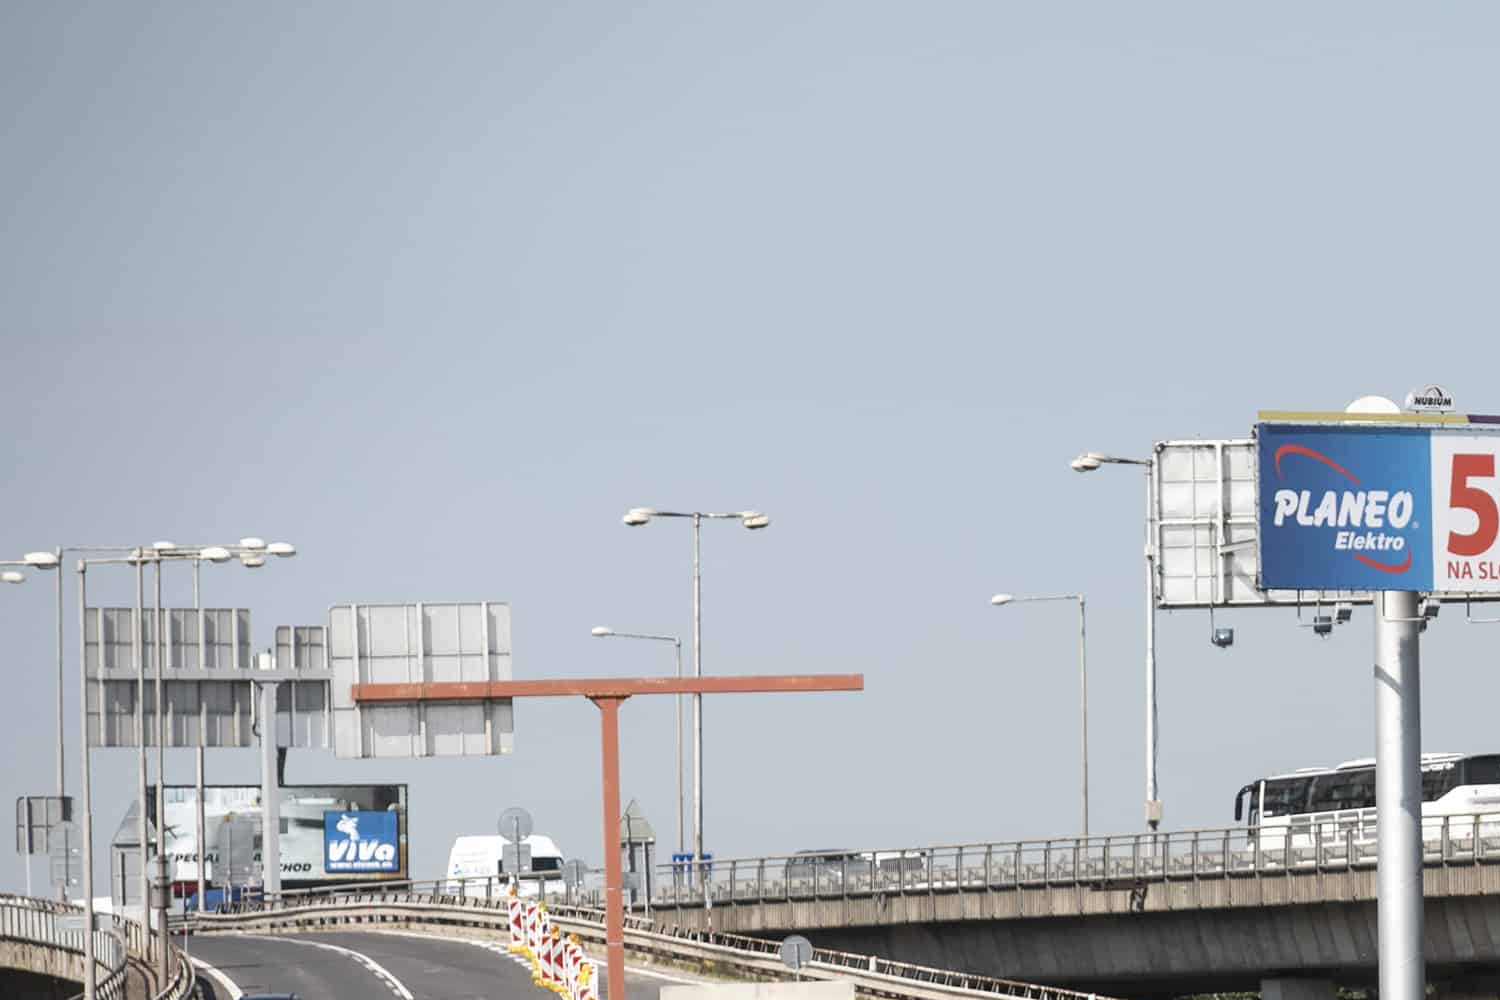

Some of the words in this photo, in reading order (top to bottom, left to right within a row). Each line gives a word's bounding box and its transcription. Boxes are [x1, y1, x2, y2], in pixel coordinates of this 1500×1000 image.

[1414, 396, 1452, 407] NUBIUM
[1273, 489, 1413, 528] PLANEO
[1335, 531, 1405, 551] Elektro
[1447, 561, 1473, 580] NA
